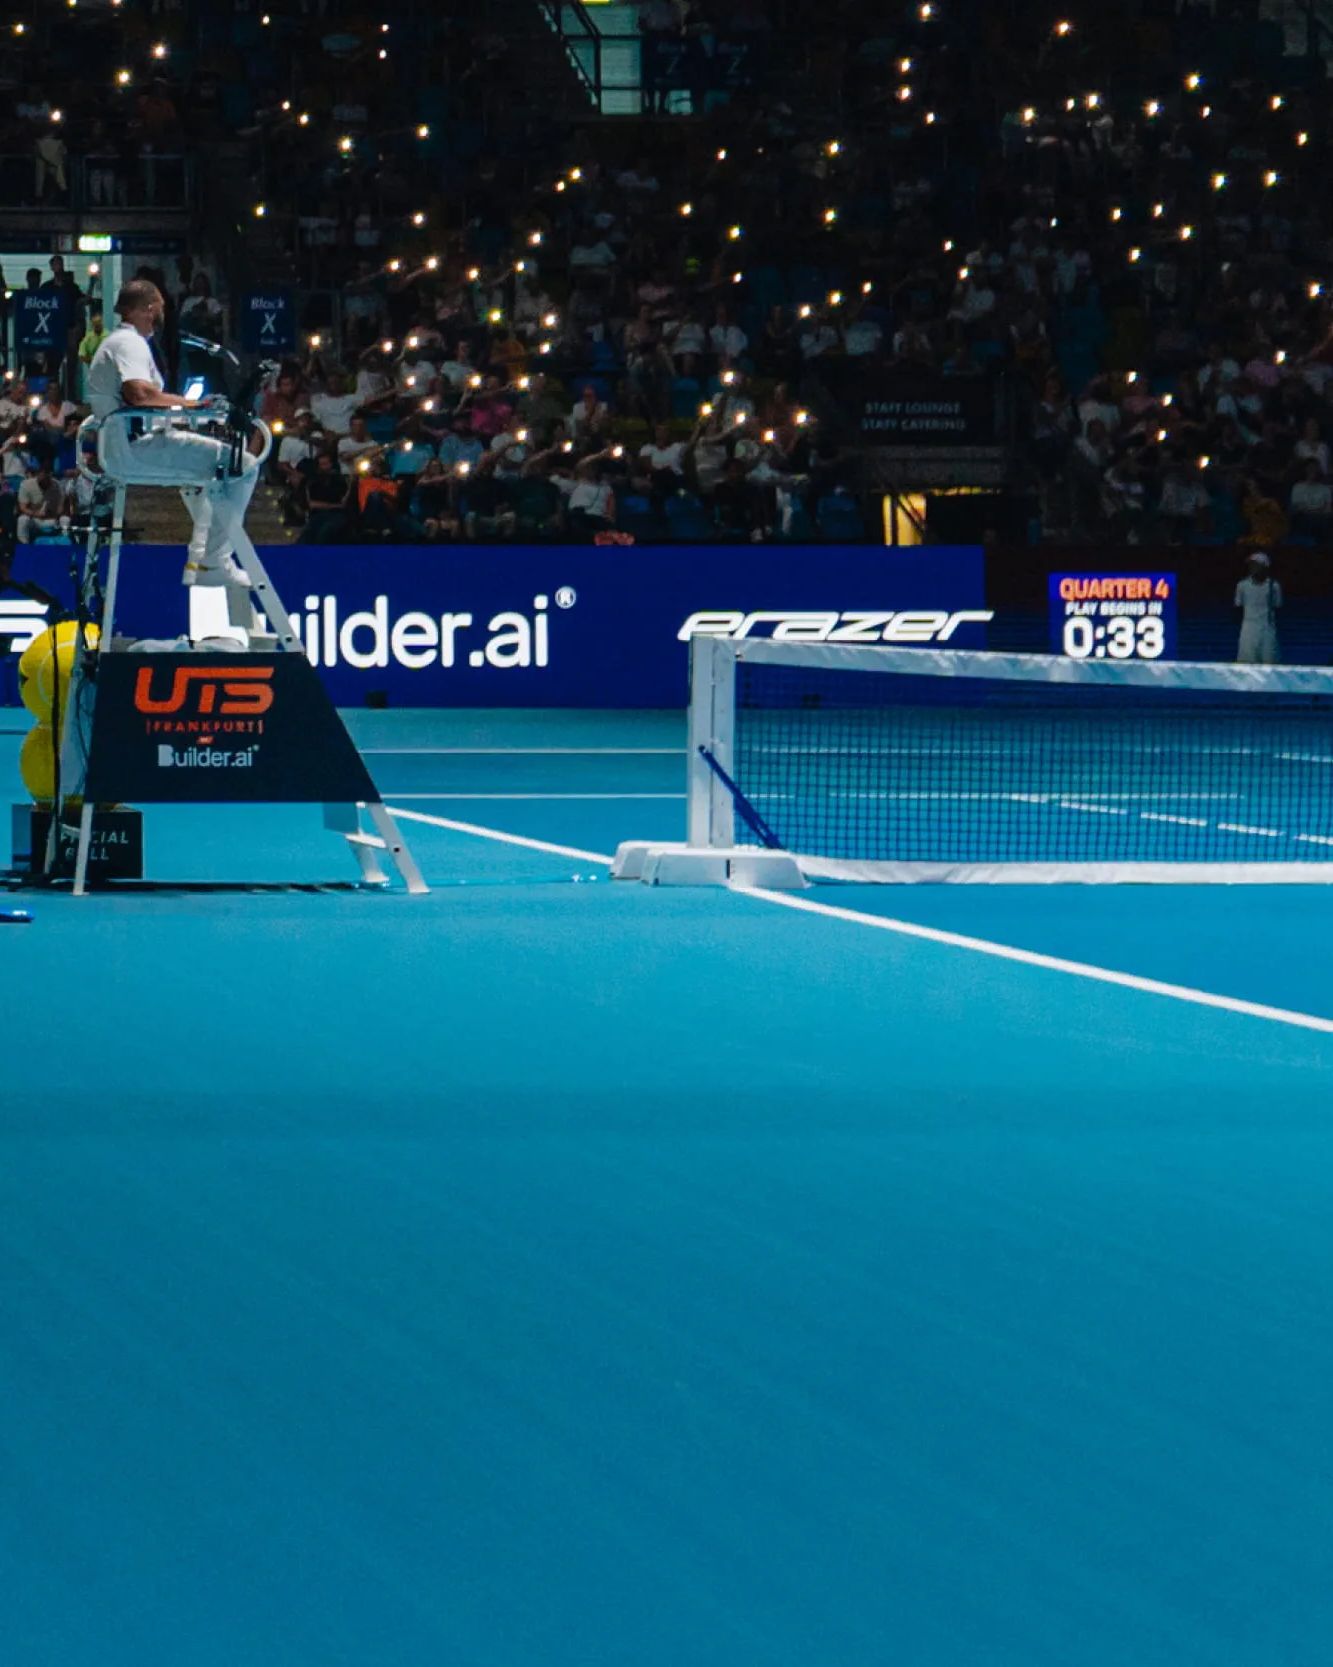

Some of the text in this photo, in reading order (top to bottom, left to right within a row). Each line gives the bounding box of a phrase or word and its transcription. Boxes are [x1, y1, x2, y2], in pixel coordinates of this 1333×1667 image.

[24, 296, 59, 309] Block
[34, 311, 51, 334] X
[261, 311, 277, 334] X
[1059, 578, 1169, 600] QUARTER 4
[1065, 601, 1098, 616] PLAY
[1100, 601, 1146, 616] BEGINS
[1063, 616, 1164, 659] 0:33
[134, 667, 275, 714] UTS
[65, 847, 109, 861] BLL
